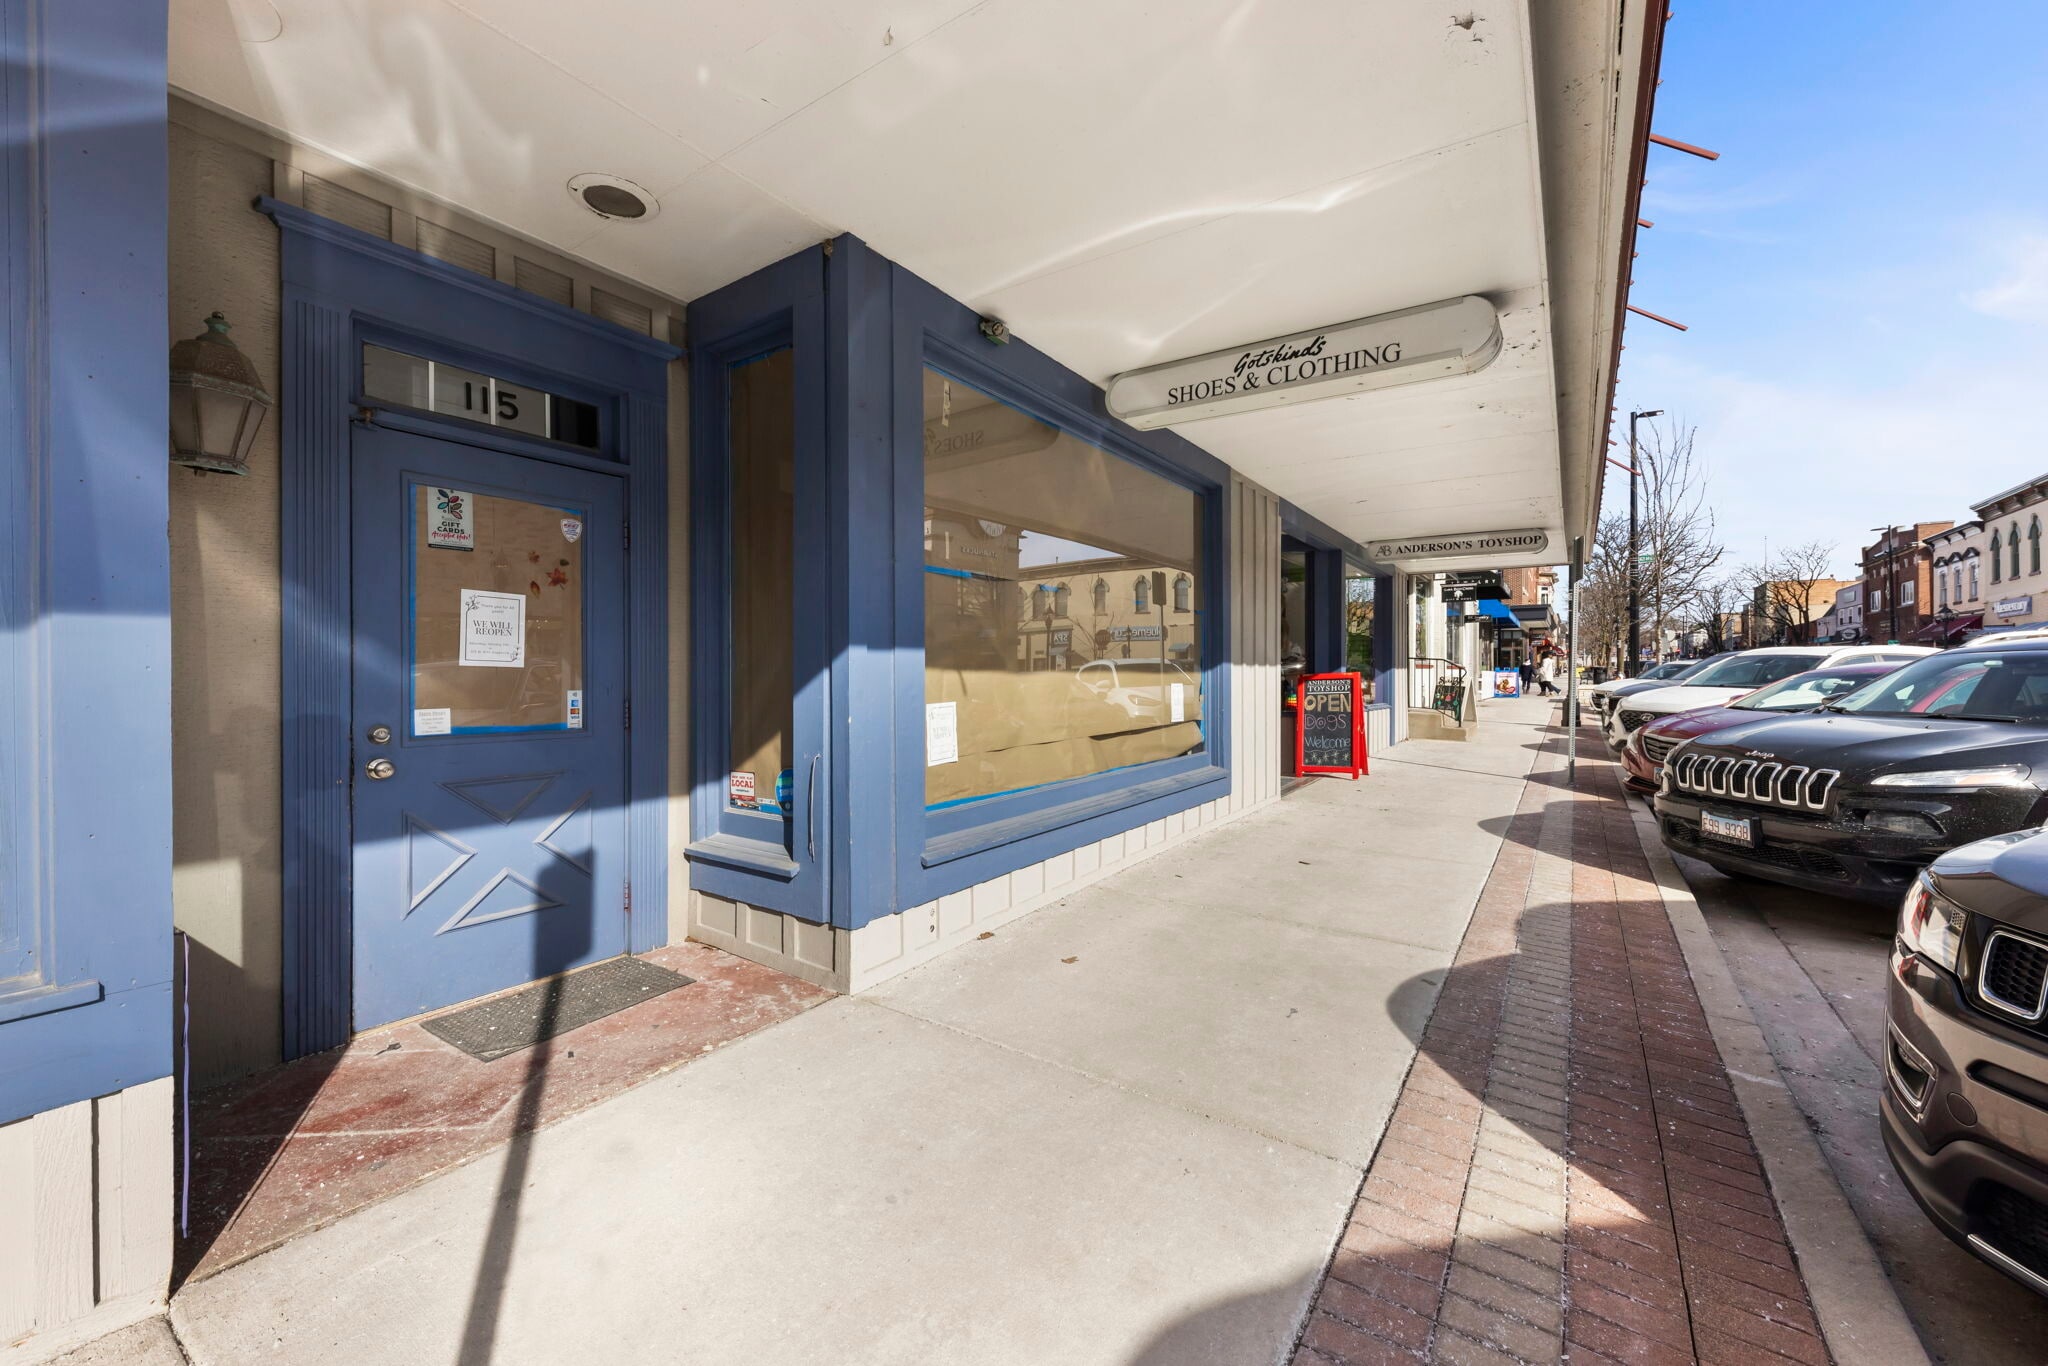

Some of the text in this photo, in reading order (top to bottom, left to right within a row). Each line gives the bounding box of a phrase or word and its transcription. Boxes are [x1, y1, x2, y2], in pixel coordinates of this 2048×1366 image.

[1234, 335, 1327, 377] Gotskind's
[1168, 343, 1401, 405] SHOES & CLOTHING
[465, 381, 519, 420] 115
[437, 526, 465, 534] CARDS
[1396, 540, 1473, 554] ANDERSON'S
[1477, 535, 1542, 548] TOYSHOP
[473, 620, 513, 630] WE WILL
[475, 628, 512, 636] REOPEN
[1304, 693, 1351, 713] OPEN
[732, 779, 753, 788] LOCAL
